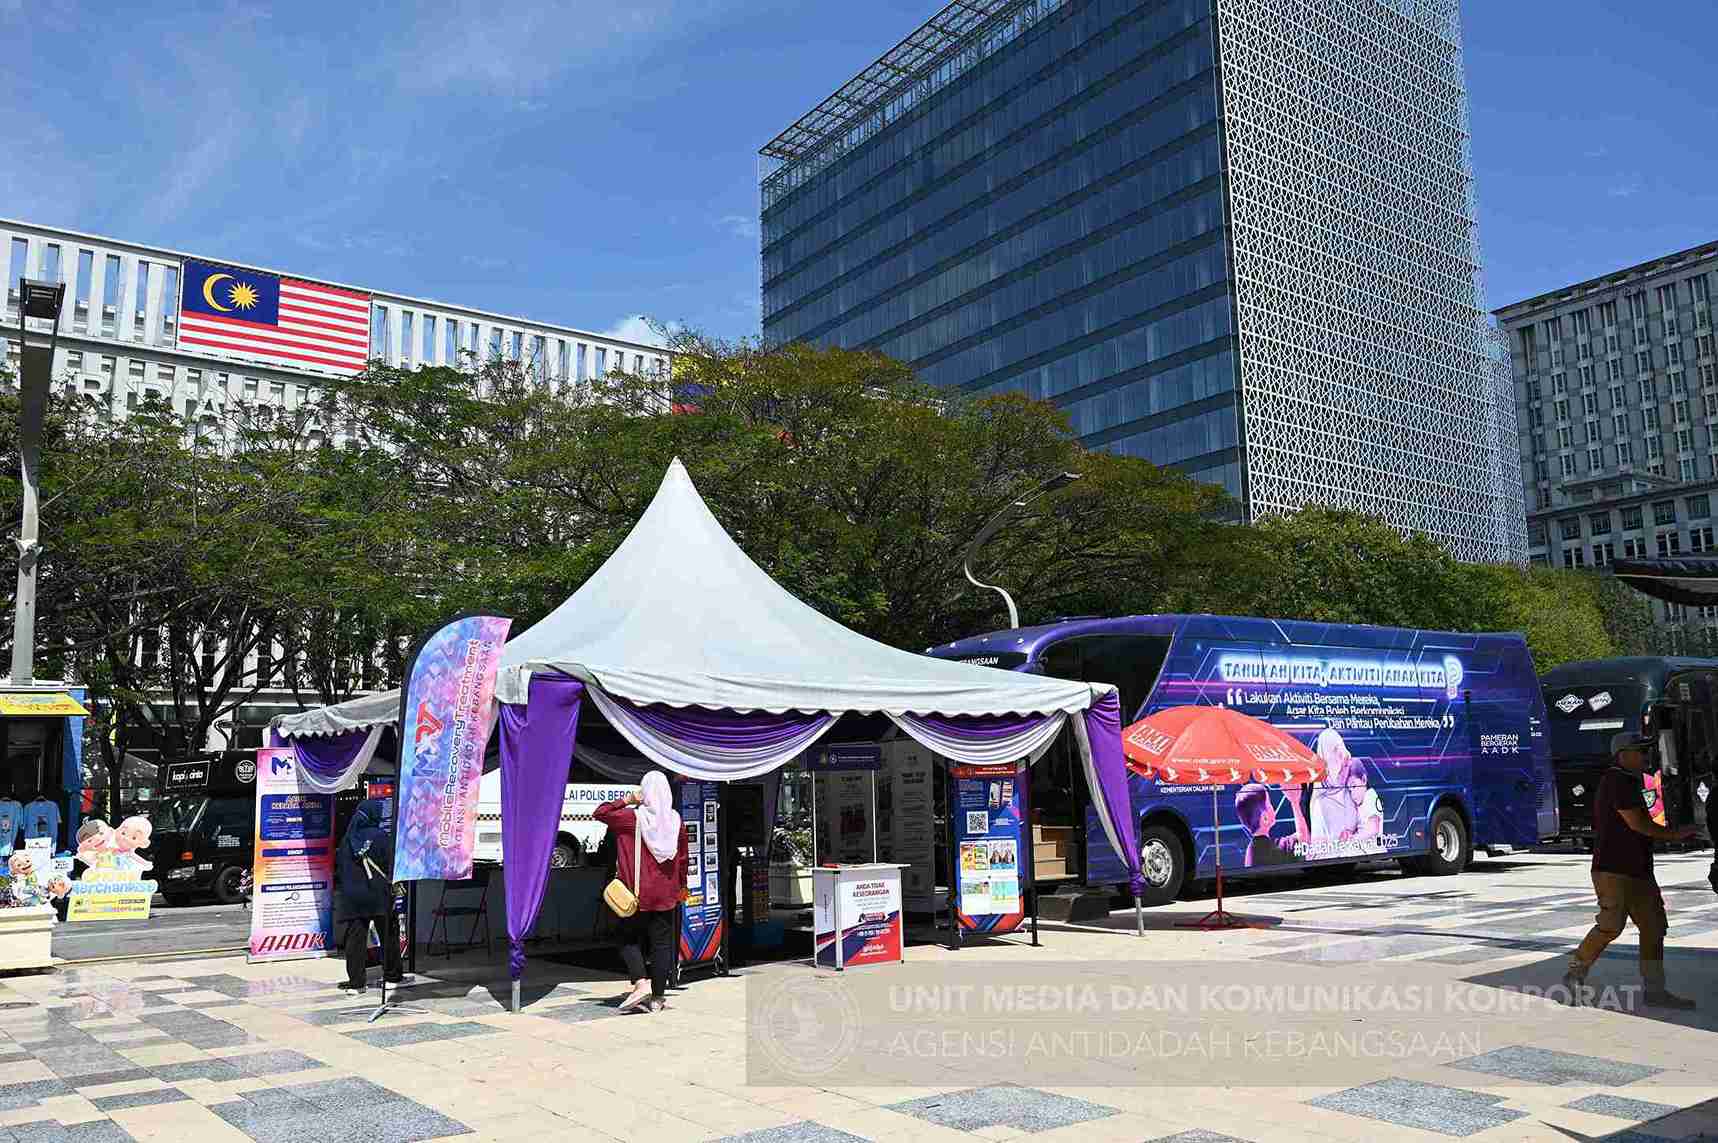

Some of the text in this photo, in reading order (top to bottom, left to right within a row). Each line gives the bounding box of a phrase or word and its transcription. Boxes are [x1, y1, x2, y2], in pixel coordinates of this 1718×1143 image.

[1224, 662, 1288, 680] TAHUKAH
[1330, 665, 1381, 682] AKTIVITI
[1385, 668, 1418, 683] ANAK
[579, 789, 606, 801] POLIS
